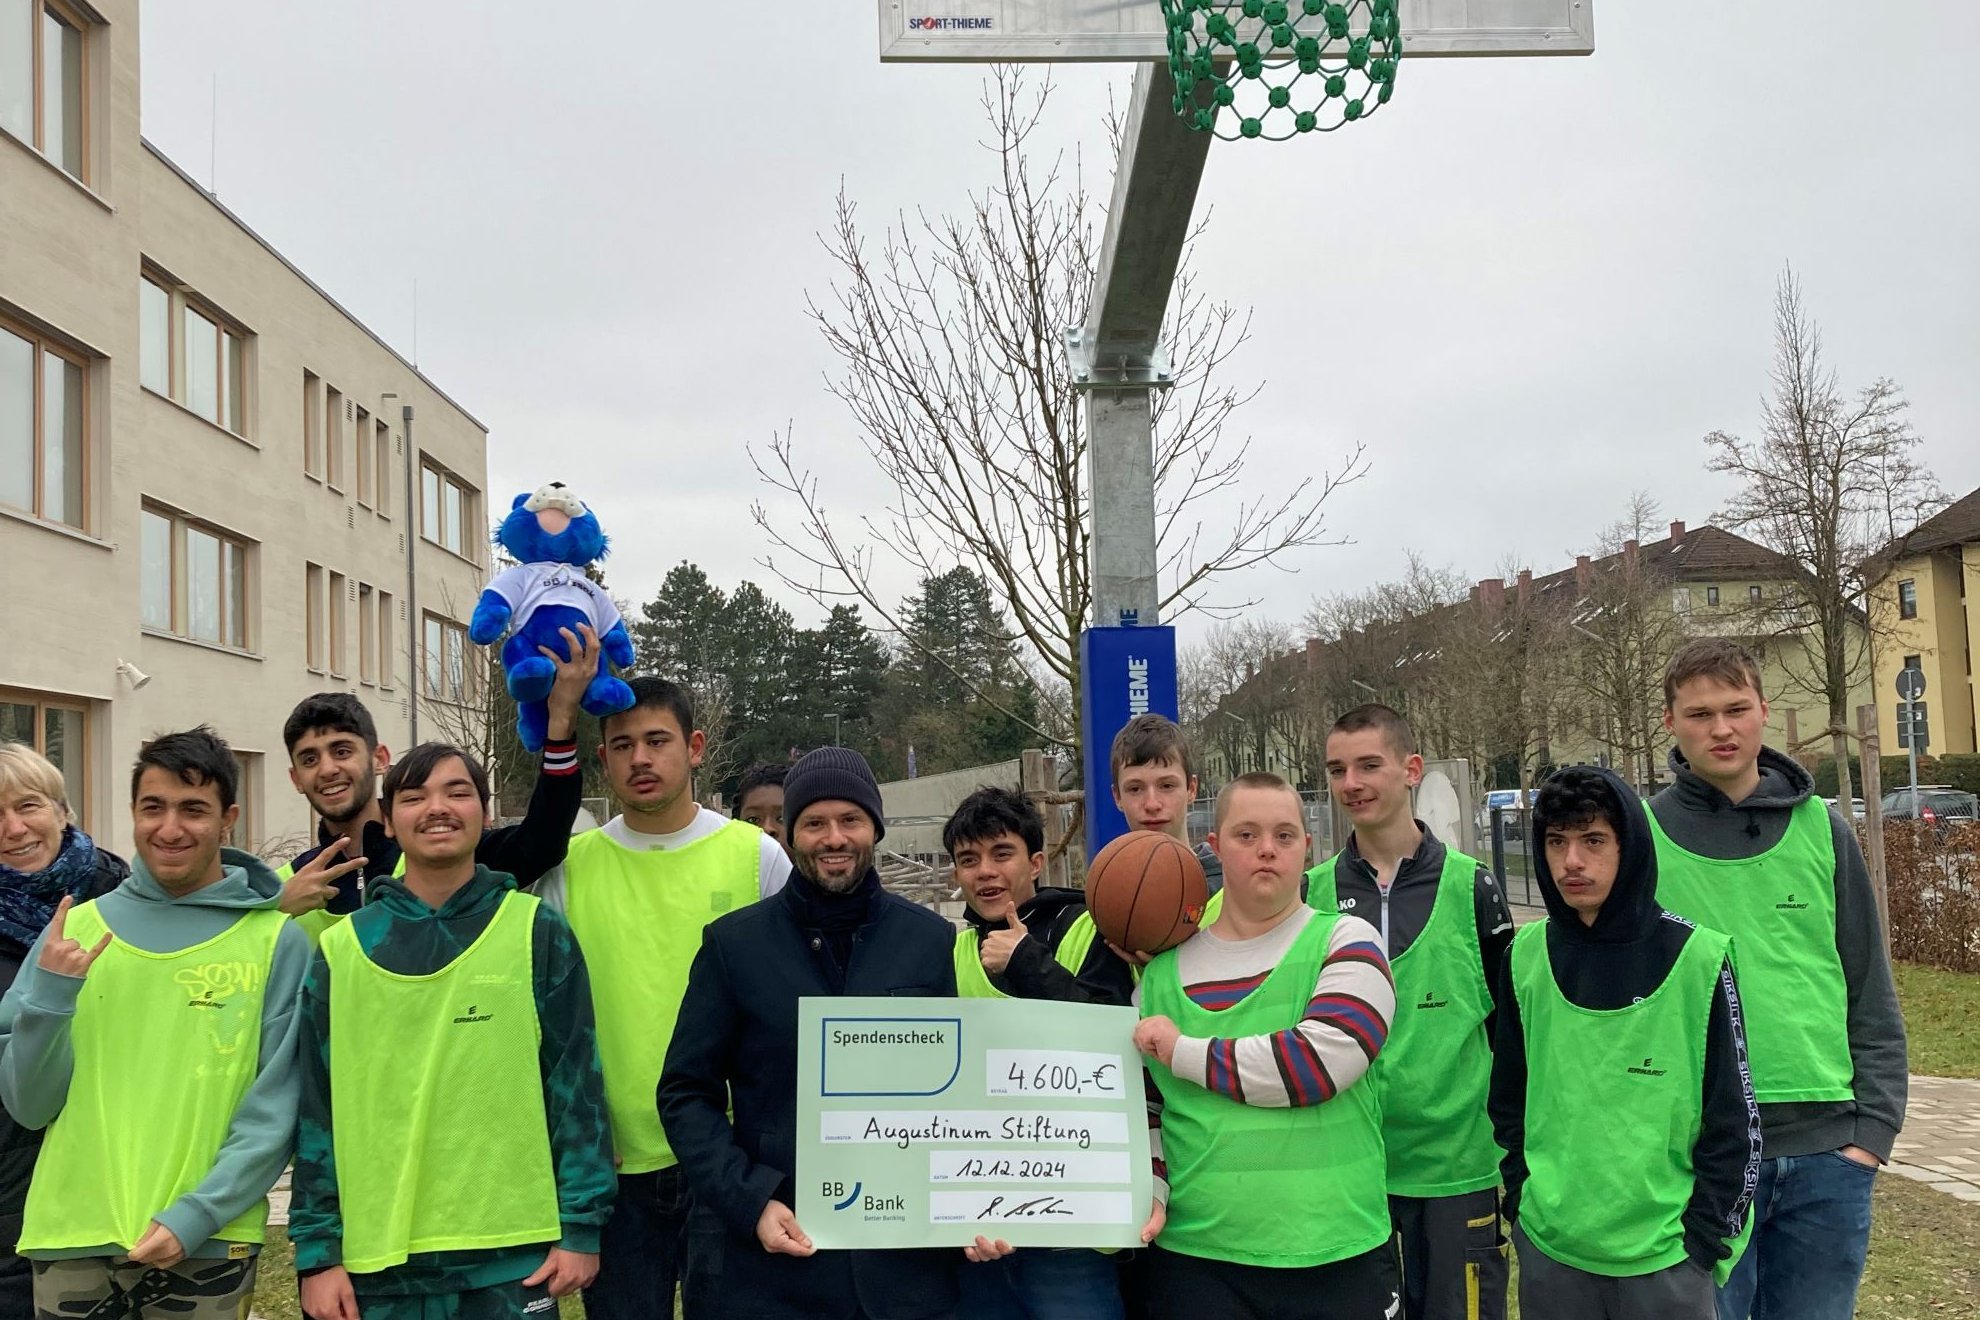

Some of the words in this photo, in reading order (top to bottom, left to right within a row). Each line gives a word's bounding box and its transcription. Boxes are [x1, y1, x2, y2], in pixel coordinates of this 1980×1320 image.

[1337, 897, 1357, 911] KO
[832, 1030, 945, 1046] Spendenscheck
[863, 1116, 992, 1149] Augustinum
[1001, 1115, 1091, 1149] Stiftung
[822, 1181, 845, 1197] BB
[864, 1194, 905, 1211] Bank
